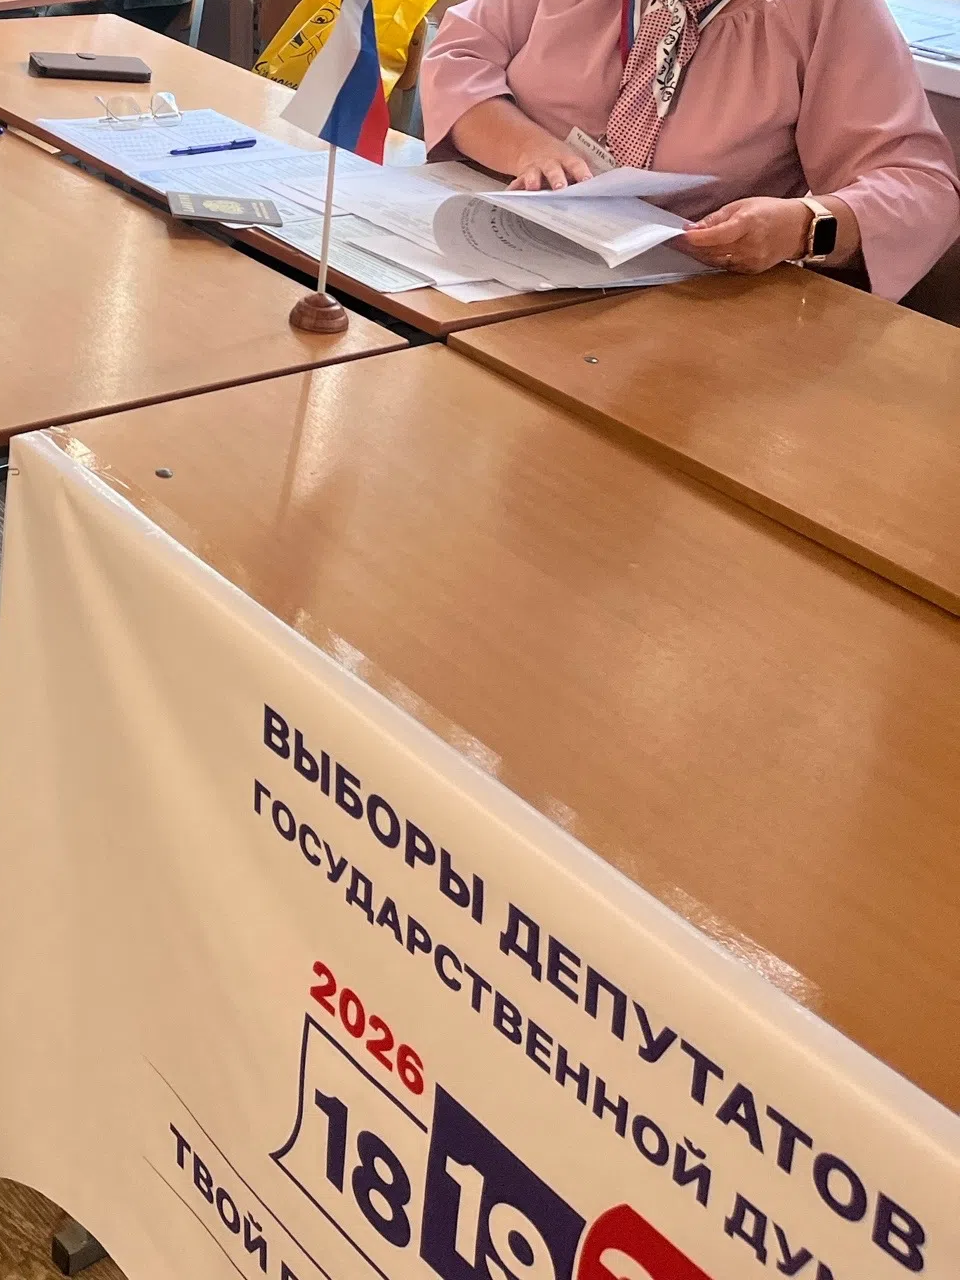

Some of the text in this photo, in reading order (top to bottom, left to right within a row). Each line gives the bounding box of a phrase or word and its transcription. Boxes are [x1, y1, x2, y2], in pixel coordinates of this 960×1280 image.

[253, 779, 837, 1280] ГОСУДАРСТВЕННОЙ ДУ
[263, 702, 927, 1273] ВЫБОРЫ ДЕПУТАТОВ
[310, 961, 426, 1097] 2026
[169, 1121, 268, 1274] ТВОЙ
[313, 1087, 413, 1249] 18
